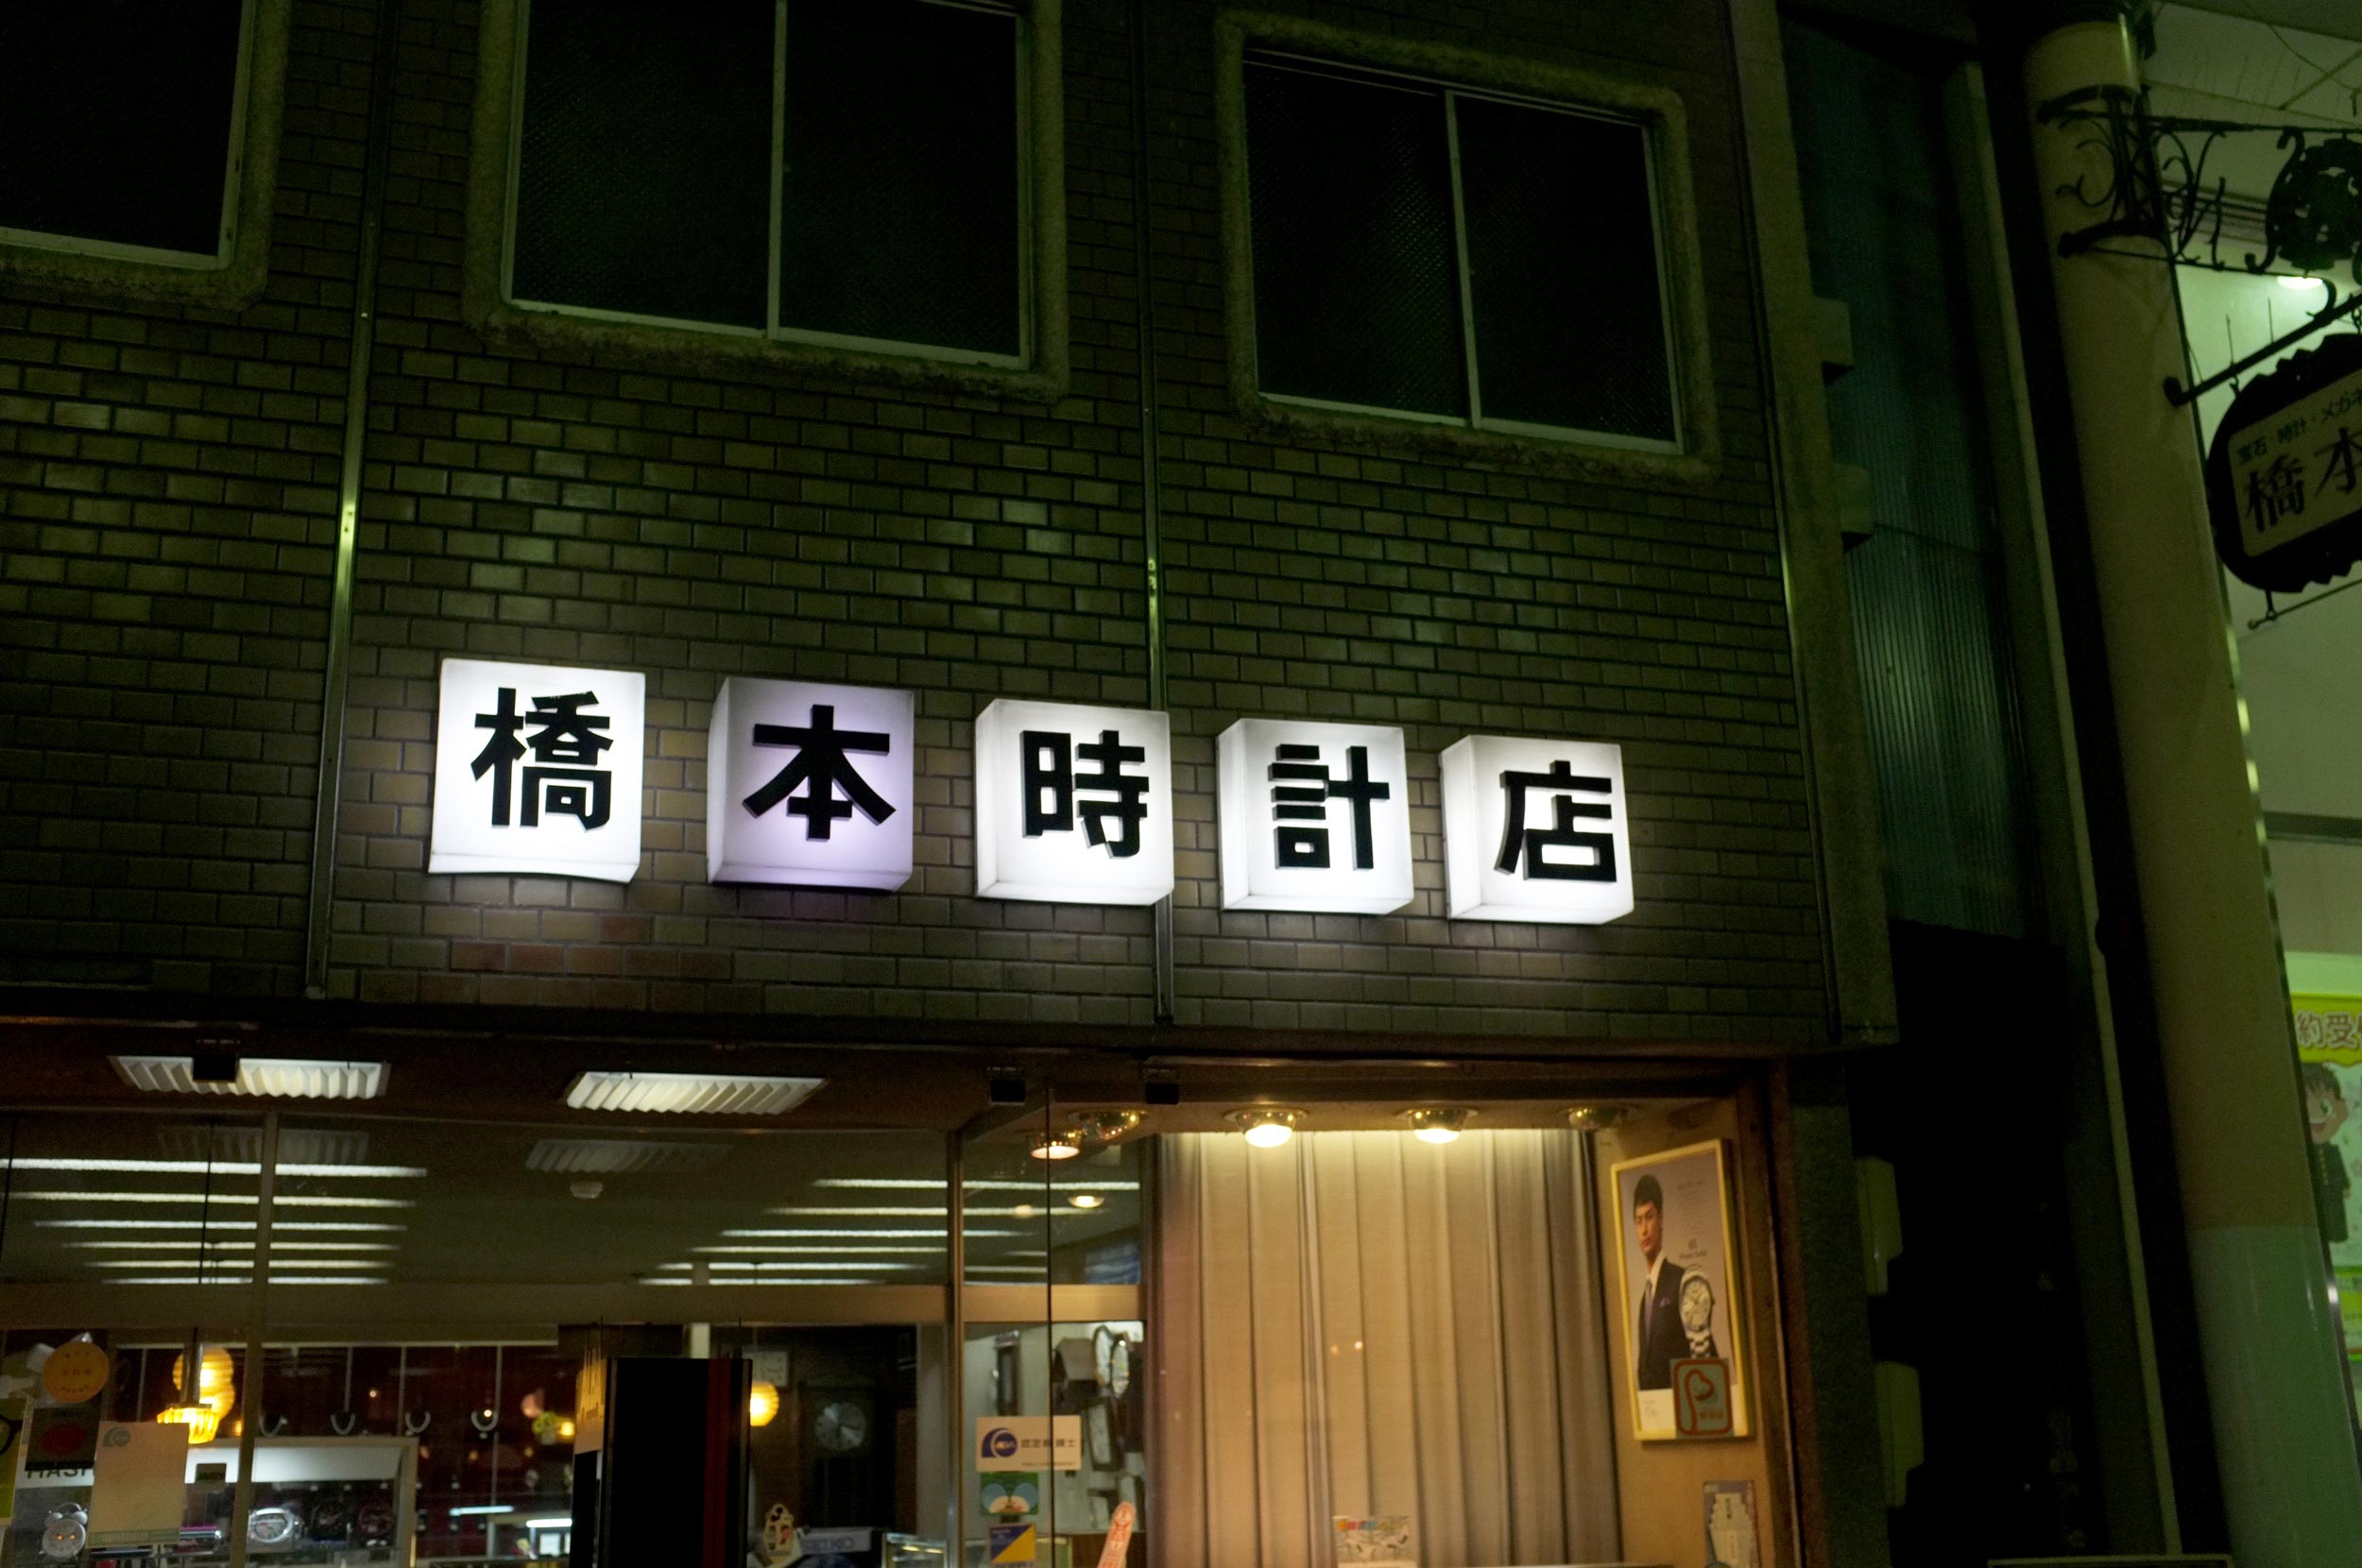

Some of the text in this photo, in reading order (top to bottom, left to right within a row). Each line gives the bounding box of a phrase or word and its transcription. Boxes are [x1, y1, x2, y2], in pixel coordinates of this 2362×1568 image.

[471, 688, 1618, 881] 橋本時計店
[2295, 1011, 2362, 1049] 約受
